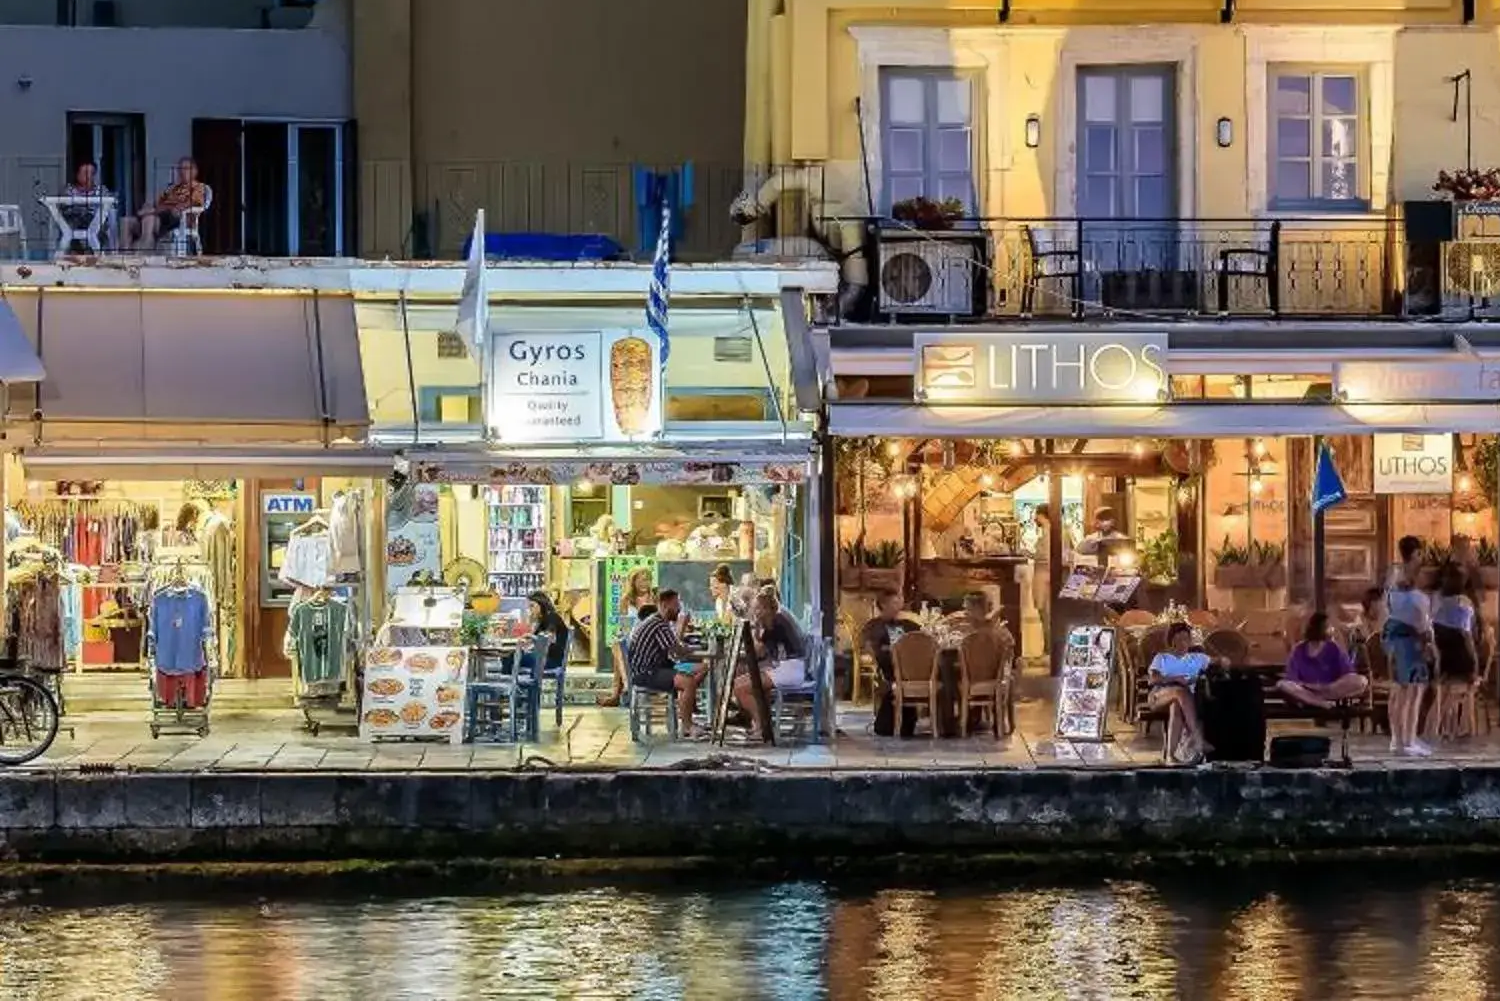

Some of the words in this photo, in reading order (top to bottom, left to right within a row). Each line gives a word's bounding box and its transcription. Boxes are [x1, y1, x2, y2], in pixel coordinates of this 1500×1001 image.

[509, 340, 585, 366] Gyros
[988, 344, 1163, 390] LITHOS
[517, 370, 578, 386] Chania
[1379, 456, 1448, 476] LITHOS
[268, 498, 313, 512] ATM
